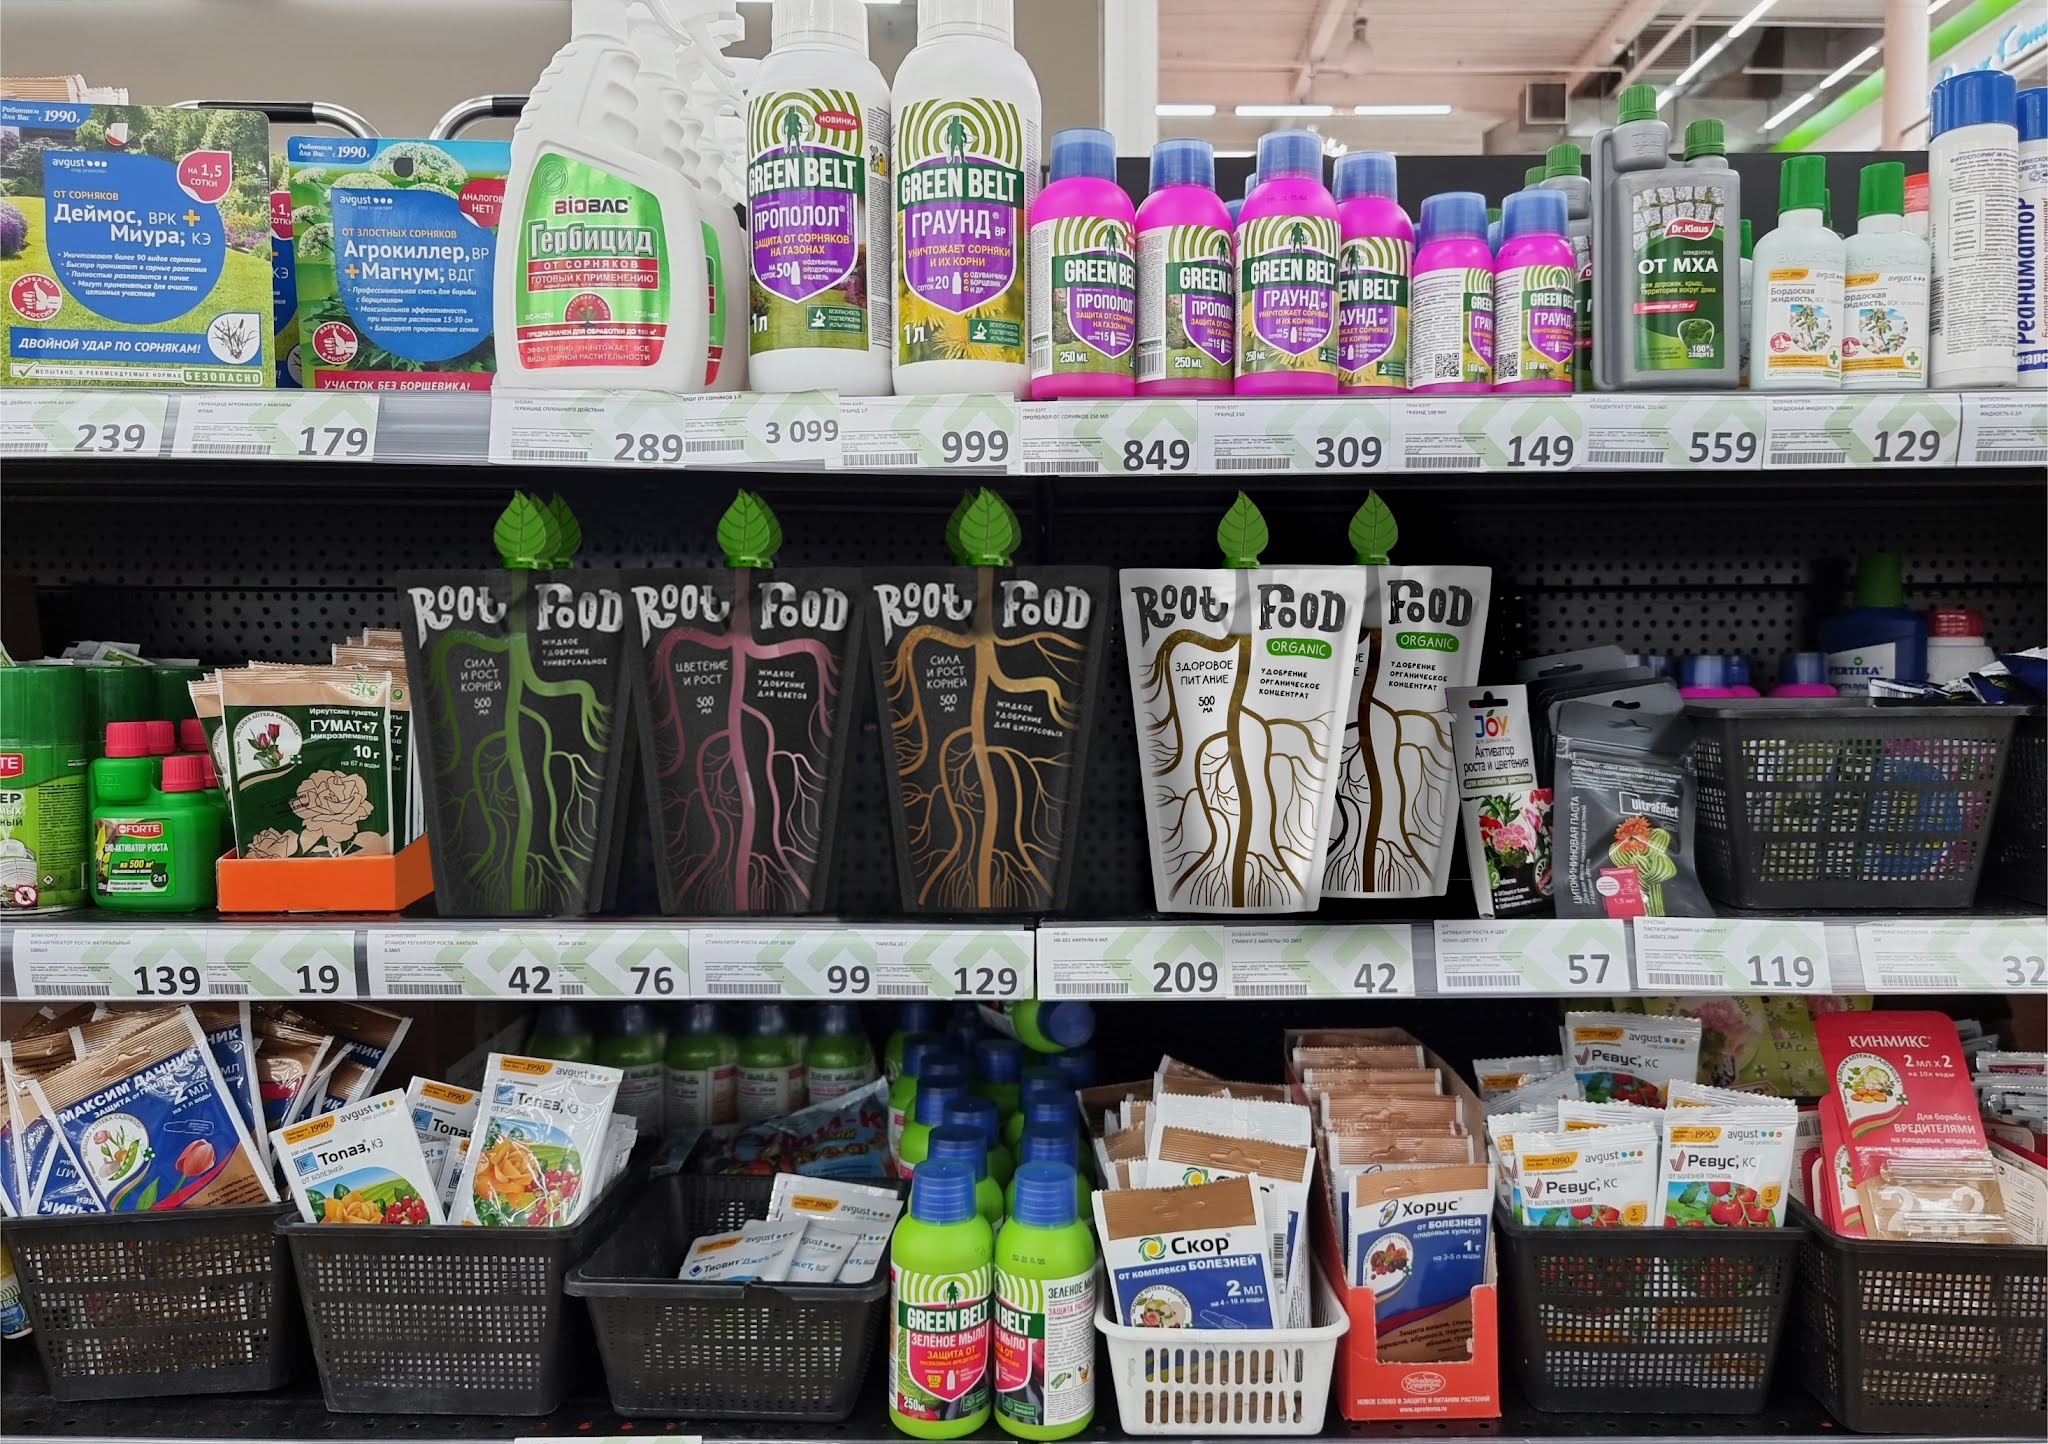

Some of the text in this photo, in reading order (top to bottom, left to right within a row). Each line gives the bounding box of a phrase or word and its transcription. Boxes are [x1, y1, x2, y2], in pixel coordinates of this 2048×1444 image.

[819, 115, 857, 127] НОВИНКА
[52, 158, 85, 168] avgust
[188, 164, 222, 178] НА 1,5
[749, 158, 857, 196] GREEN BELT
[190, 178, 218, 187] СОТКИ
[902, 168, 1017, 205] GREEN BELT
[54, 190, 119, 200] ОТ СОРНЯКОВ
[340, 195, 371, 207] avgust
[462, 193, 503, 203] АНАЛОГОВ
[54, 203, 177, 227] Деймос, ВРК
[472, 204, 494, 214] НЕТ!
[342, 228, 457, 239] ОТ ЗЛОСТНЫХ СОРНЯКОВ
[995, 227, 1006, 237] ВР
[1671, 224, 1710, 234] Dr.Klaus
[192, 233, 212, 245] КЭ
[530, 224, 654, 258] Гербицид
[755, 233, 850, 249] ЗАЩИТА ОТ СОРНЯКОВ
[63, 251, 113, 261] Уничтожают
[115, 253, 135, 261] более
[344, 240, 489, 262] Агрокиллер, ВР
[770, 245, 825, 256] НА ГАЗОНАХ
[908, 245, 1011, 258] УНИЧТОЖАЕТ СОРНЯКИ
[544, 259, 638, 270] ОТ СОРНЯКОВ
[938, 257, 985, 267] ИХ КОРНИ
[1638, 257, 1718, 275] ОТ МХА
[449, 268, 475, 282] ВДГ
[531, 273, 654, 284] ГОТОВЫЙ ПРИМЕНЕНИЮ
[1064, 260, 1116, 284] GREEN
[1251, 259, 1336, 285] GREEN BELT
[1362, 279, 1399, 300] BELT
[1770, 287, 1815, 299] Бордоская
[1770, 296, 1814, 304] жидкость,
[19, 337, 201, 354] ДВОЙНОЙ УДАР ПО СОРНЯКАМ!
[186, 371, 259, 383] БЕЗОПАСНО
[73, 424, 146, 451] 239
[765, 422, 781, 444] 3
[298, 427, 369, 456] 179
[614, 433, 683, 463] 289
[942, 430, 1008, 463] 999
[1689, 432, 1757, 463] 559
[1873, 430, 1940, 462] 129
[1123, 439, 1190, 471] 849
[1315, 436, 1382, 468] 309
[1507, 436, 1574, 467] 149
[1271, 641, 1327, 656] ORGANIC
[1401, 634, 1454, 650] ORGANIC
[464, 658, 495, 668] СИЛА
[676, 660, 729, 673] ЦВЕТЕНИЕ
[1175, 659, 1234, 673] ЗДОРОВОЕ
[471, 670, 499, 680] РОСТ
[694, 675, 722, 685] РОСТ
[1181, 674, 1229, 686] ПИТАНИЕ
[1261, 668, 1308, 679] УДОБРЕНИЕ
[461, 680, 502, 692] КОРНЕЙ
[1260, 678, 1320, 690] ОРГАНИЧЕСКОЕ
[1258, 689, 1309, 699] КОНЦЕНТРАТ
[474, 697, 492, 708] 500
[309, 708, 379, 717] Иркутские гуматы
[311, 719, 378, 734] ГУМАТ+7
[311, 733, 379, 742] микроэлементов
[353, 745, 380, 759] 10 г
[1475, 745, 1515, 759] Активатор
[1463, 758, 1529, 776] роста и цветения
[1632, 798, 1679, 818] UltraEffect
[125, 824, 160, 834] FORTE
[1569, 954, 1610, 984] 57
[1748, 956, 1814, 987] 119
[134, 966, 201, 995] 139
[297, 965, 340, 993] 19
[508, 966, 553, 994] 42
[630, 967, 674, 994] 76
[827, 965, 870, 994] 99
[954, 967, 1017, 995] 129
[1153, 962, 1218, 993] 209
[1353, 963, 1398, 993] 42
[1849, 1035, 1930, 1048] КИНМИКС
[340, 1104, 373, 1124] avgust
[1917, 1112, 1966, 1122] Для борьбы
[1728, 1129, 1758, 1141] avgust
[1894, 1124, 1976, 1135] ВРЕДИТЕЛЯМИ
[371, 1137, 384, 1149] КЭ
[1585, 1150, 1618, 1163] avgust
[1743, 1157, 1757, 1168] КС
[311, 1165, 344, 1182] БОЛЕЗНЕЙ
[1603, 1178, 1618, 1188] КС
[1428, 1218, 1481, 1229] БОЛЕЗНЕЙ
[1452, 1228, 1481, 1238] культур
[1118, 1256, 1257, 1280] от комплекса БОЛЕЗНЕЙ
[1226, 1279, 1262, 1296] 2 МЛ
[907, 1301, 988, 1332] GREEN BELT
[911, 1327, 985, 1348] ЗЕЛЁНОЕ МЫЛО
